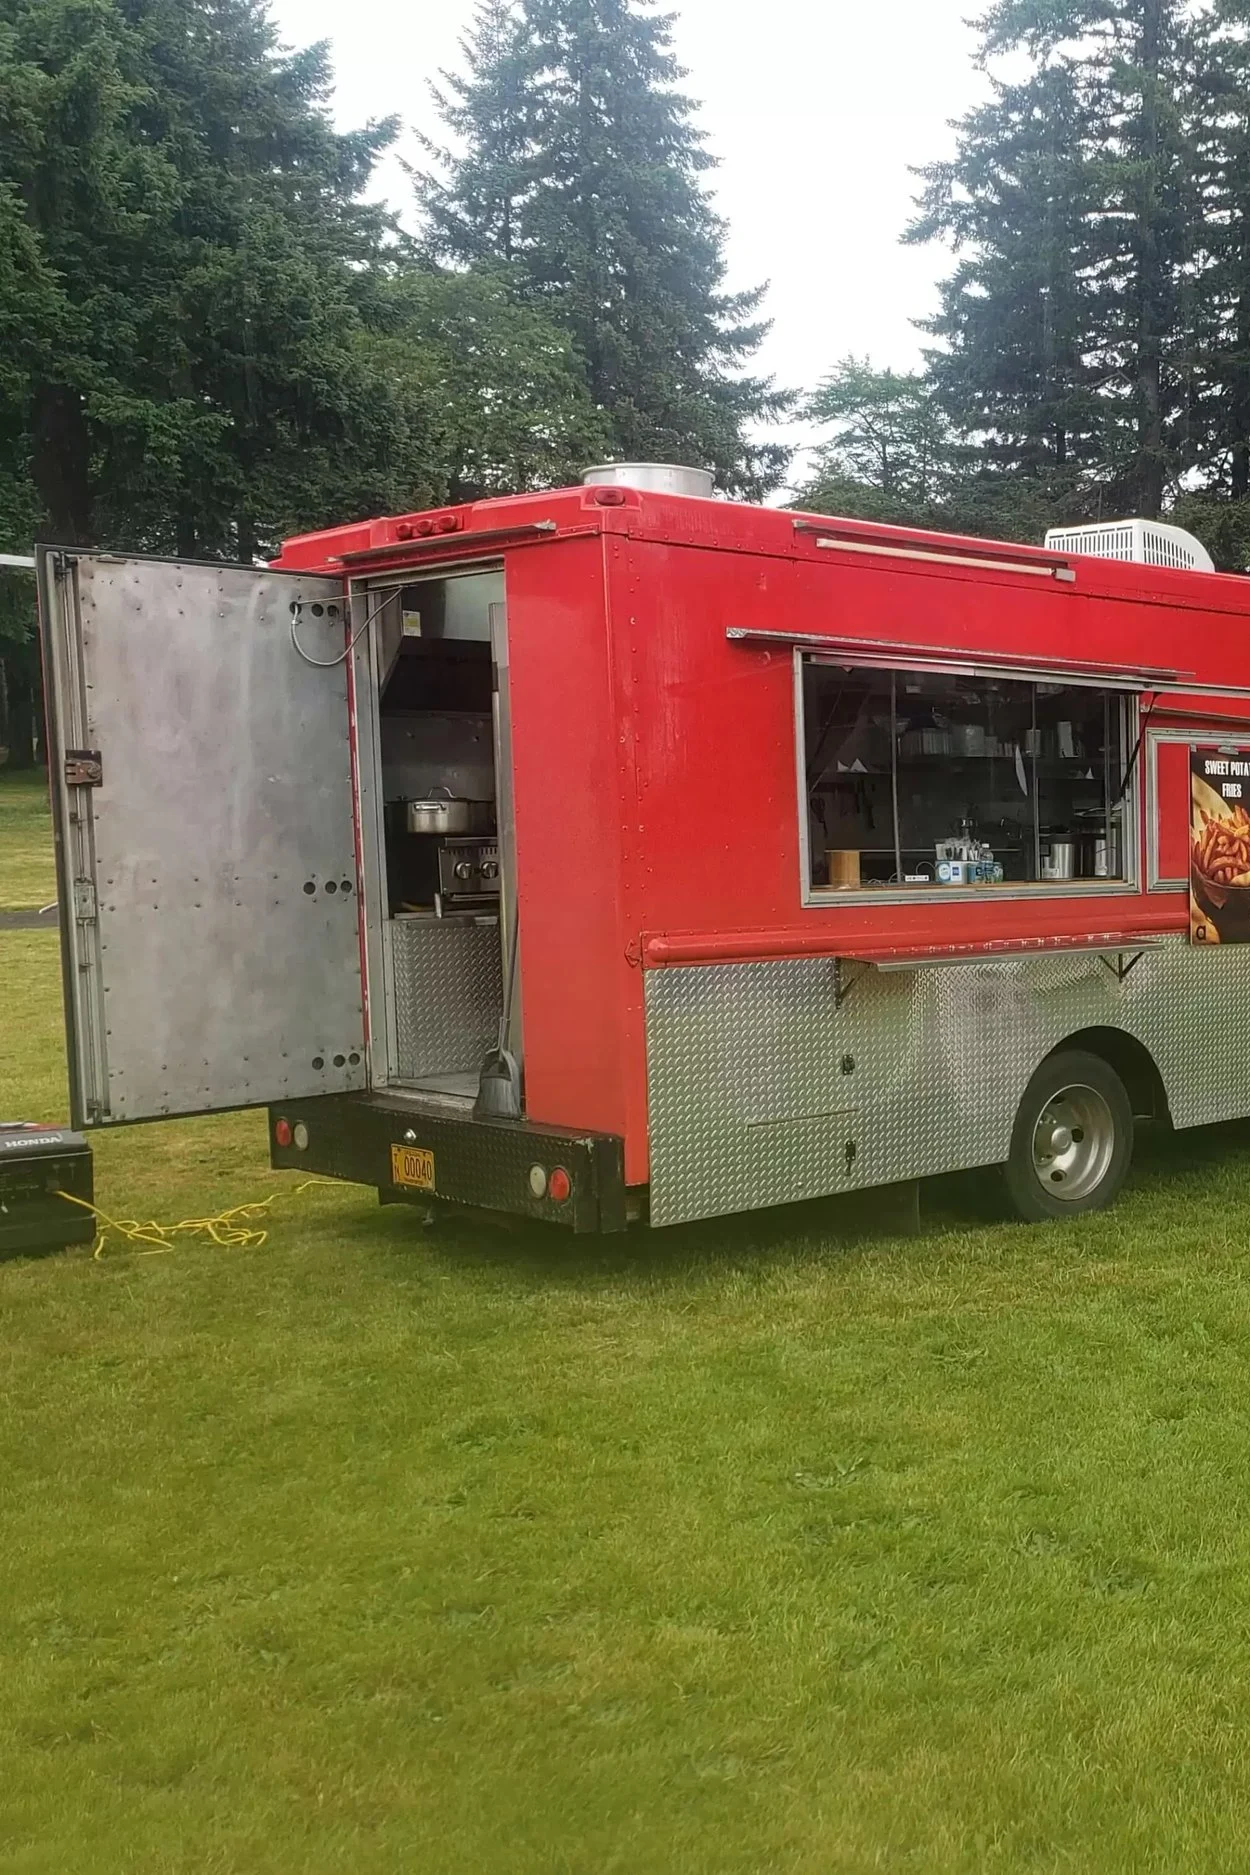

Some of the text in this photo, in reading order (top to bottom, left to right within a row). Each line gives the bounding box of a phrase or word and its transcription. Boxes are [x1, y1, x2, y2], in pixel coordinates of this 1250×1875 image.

[1205, 760, 1229, 776] SWEET
[1222, 782, 1242, 798] FRIES
[5, 1136, 61, 1148] HONDA
[404, 1155, 433, 1181] 00040
